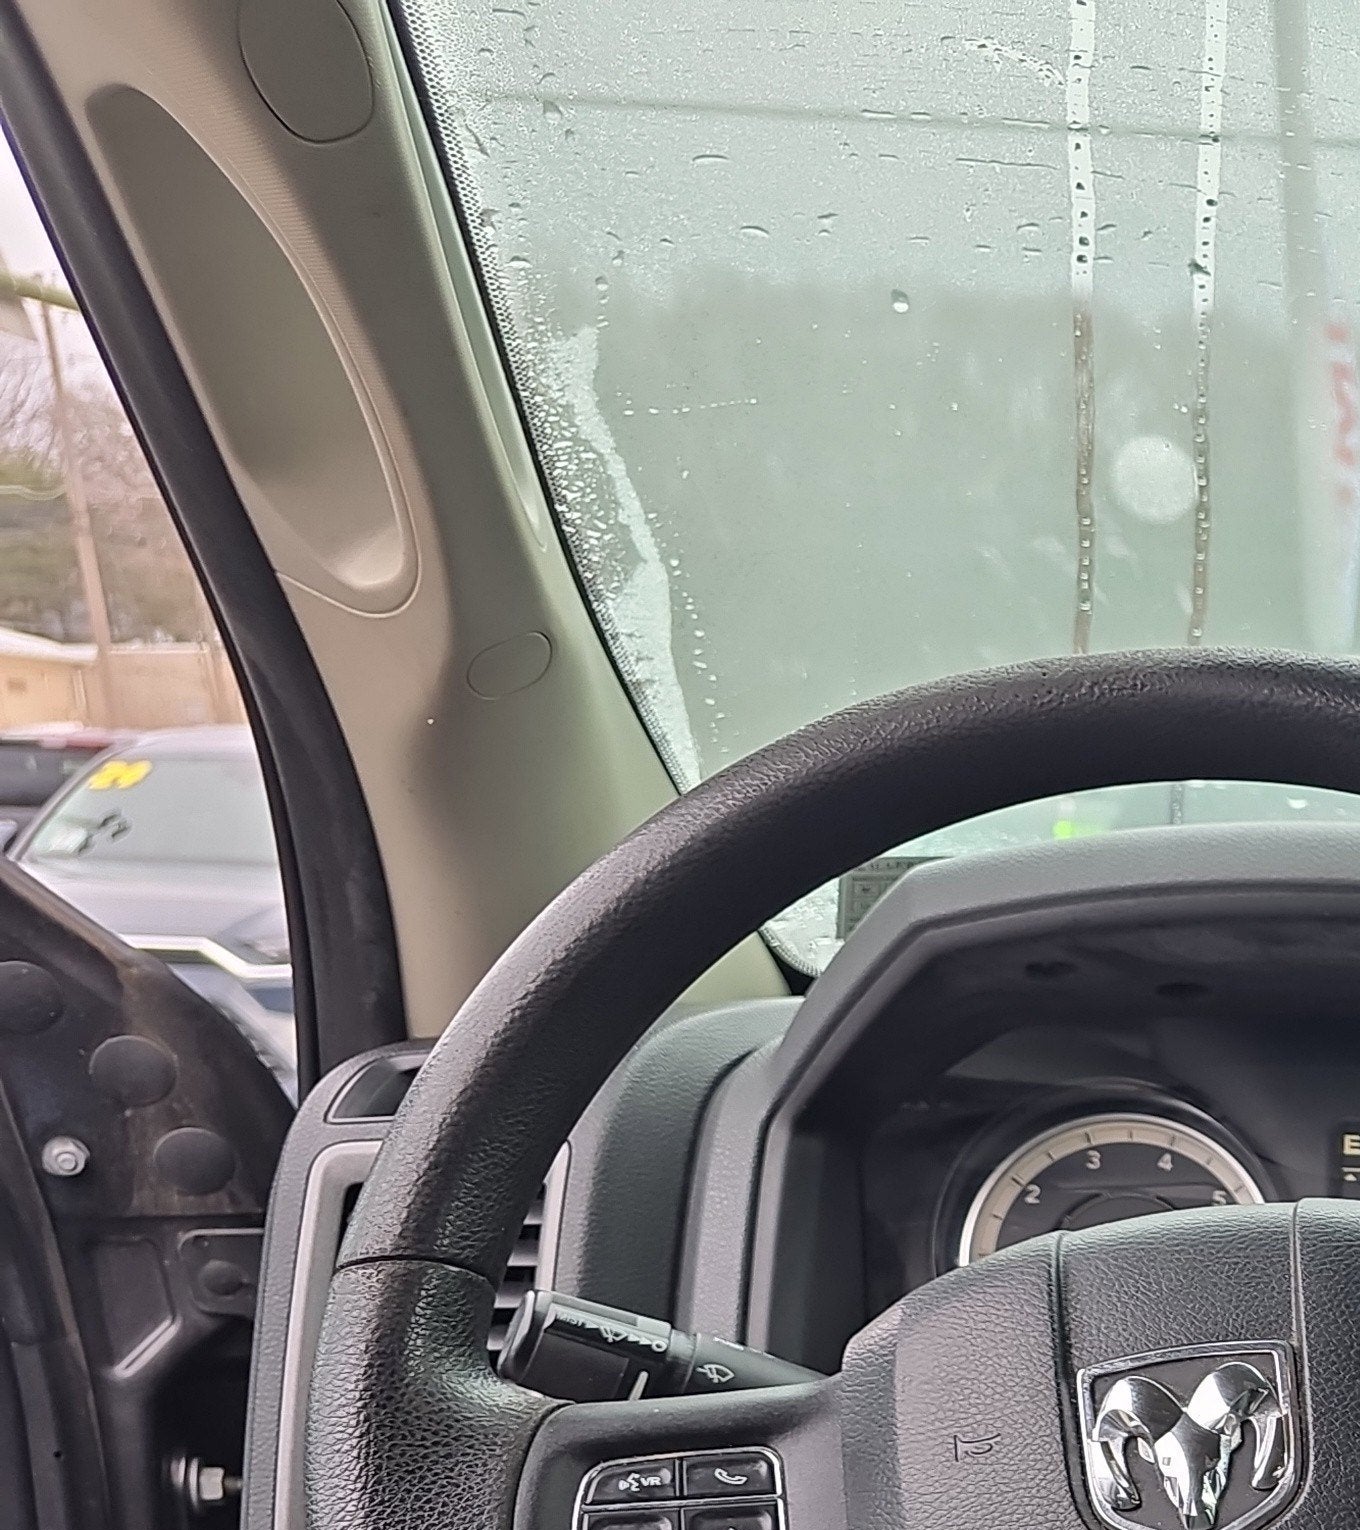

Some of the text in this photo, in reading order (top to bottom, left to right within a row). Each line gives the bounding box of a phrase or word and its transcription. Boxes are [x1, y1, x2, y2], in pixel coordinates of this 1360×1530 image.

[1343, 1134, 1360, 1155] E
[1086, 1150, 1101, 1170] 3
[1157, 1153, 1173, 1171] 4
[1024, 1184, 1041, 1204] 2
[641, 1475, 663, 1487] VR
